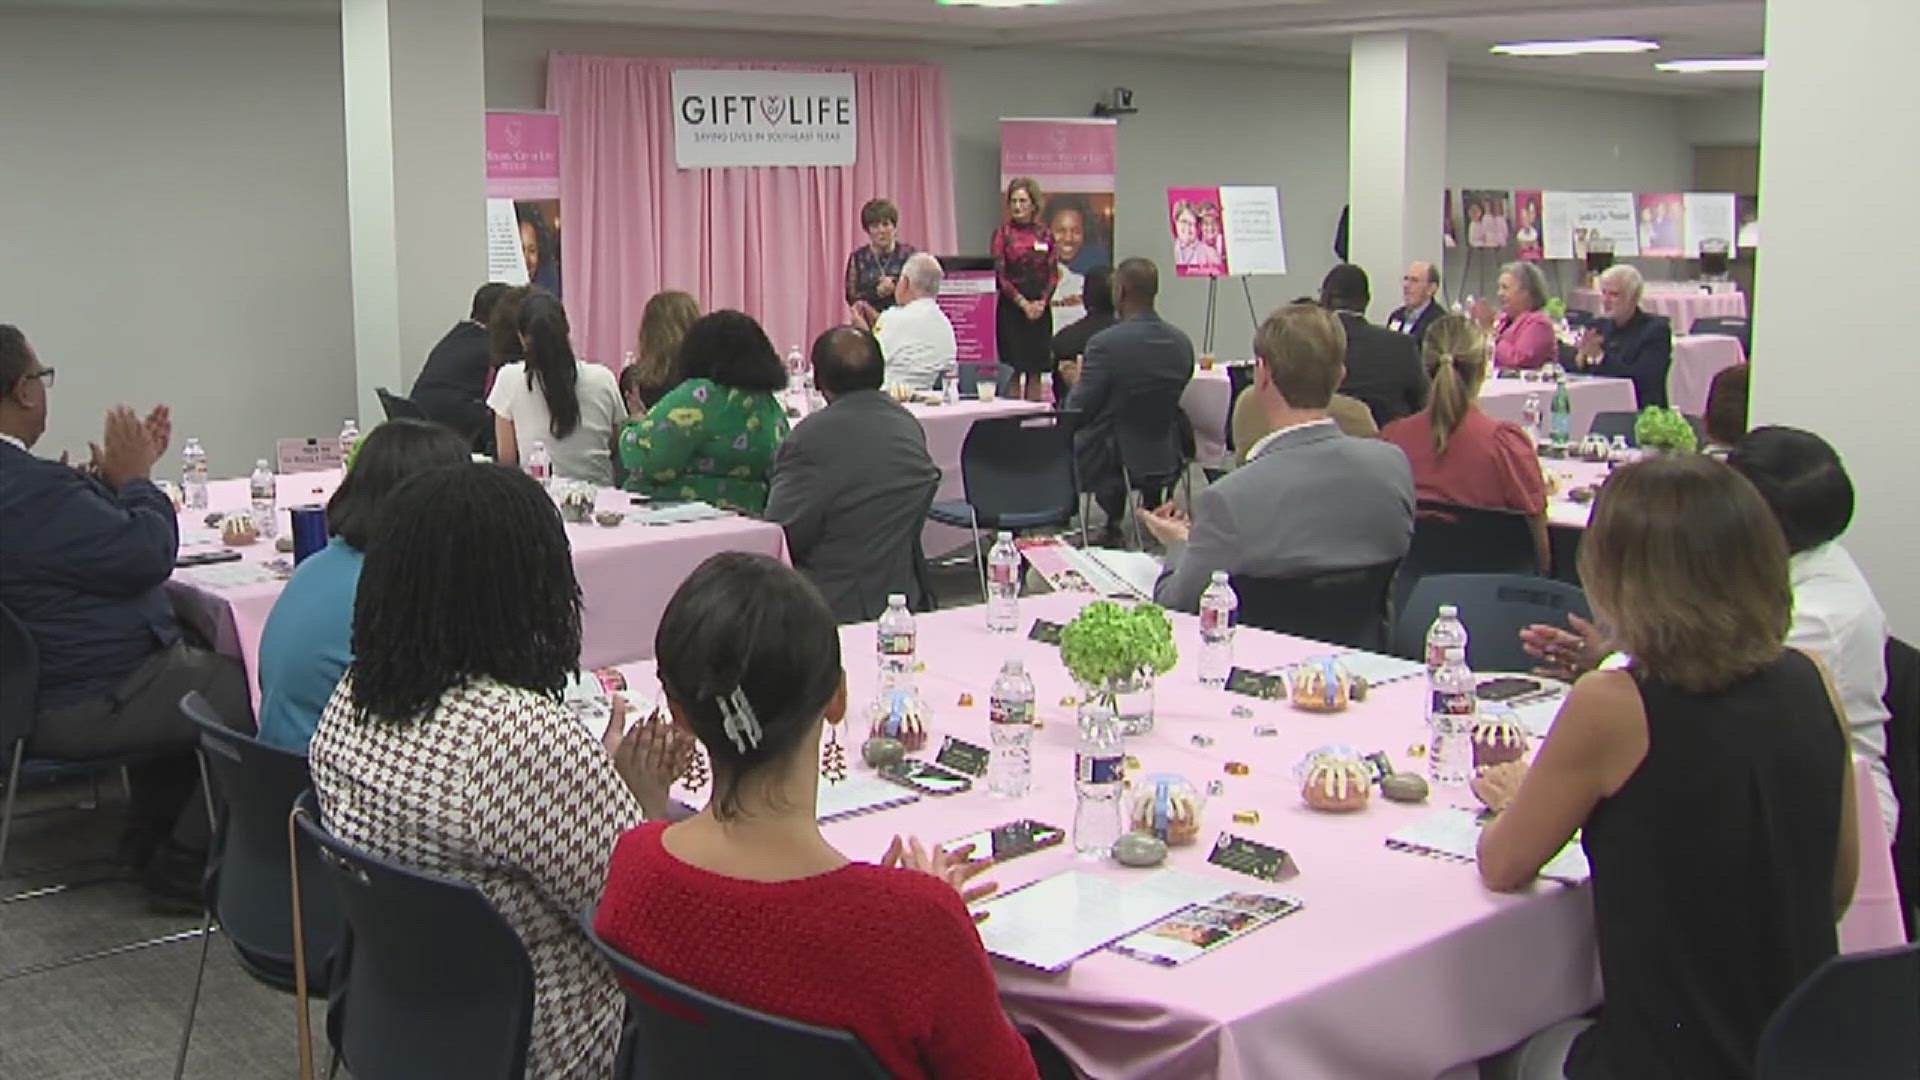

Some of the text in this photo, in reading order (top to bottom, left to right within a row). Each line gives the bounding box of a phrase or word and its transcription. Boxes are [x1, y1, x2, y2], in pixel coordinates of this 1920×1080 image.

[682, 96, 850, 125] GIFT OF LIFE
[694, 131, 840, 143] SAVING LIVES IN SOUTHEAST TEXAS
